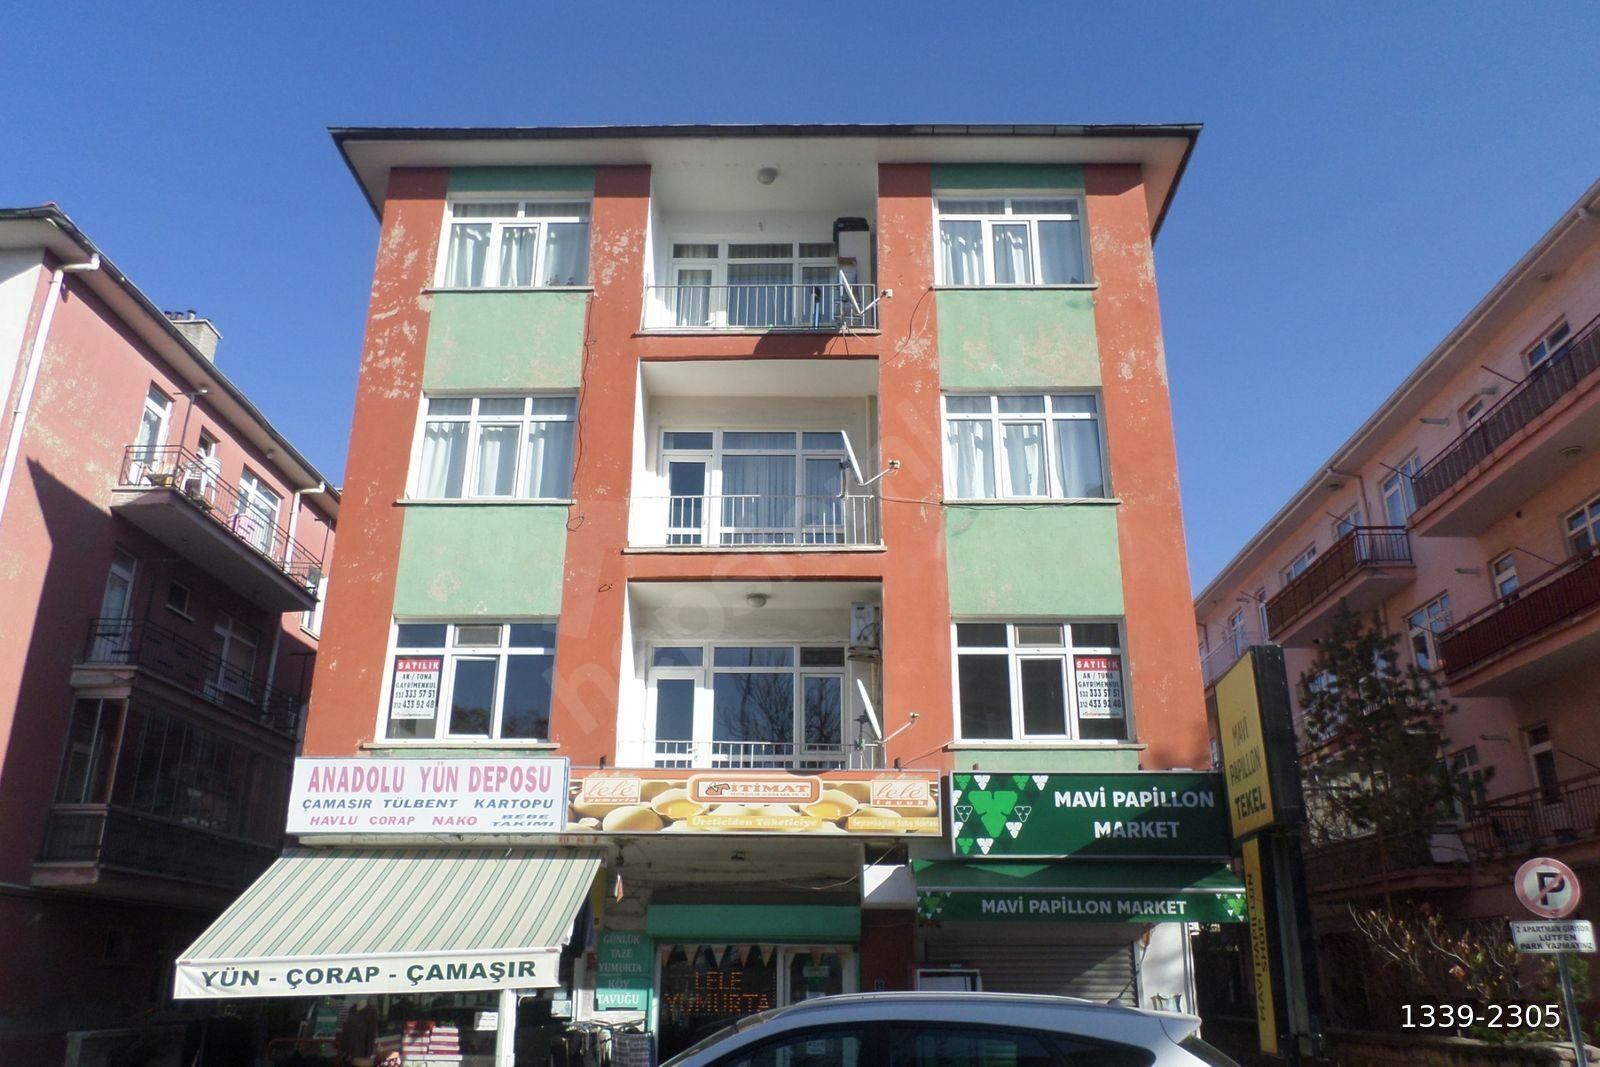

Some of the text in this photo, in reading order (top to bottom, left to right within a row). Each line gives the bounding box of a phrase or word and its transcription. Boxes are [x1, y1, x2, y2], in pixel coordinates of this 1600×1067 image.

[397, 661, 439, 670] SATILIK
[1076, 660, 1118, 669] SATILIK
[405, 690, 417, 698] 333
[1090, 689, 1102, 697] 333
[403, 700, 415, 708] 433
[1089, 700, 1102, 708] 433
[307, 762, 552, 793] ANADOLU YÜN DEPOSU
[731, 782, 809, 793] İTİMAT
[383, 797, 458, 809] TÜLBENT
[474, 799, 554, 809] KARTOPU
[1055, 787, 1214, 808] MAVİ PAPİLLON
[1235, 786, 1266, 820] TEKEL
[310, 816, 358, 826] HAVLU
[432, 816, 478, 826] NAKO
[1094, 821, 1180, 839] MARKET
[1536, 872, 1566, 906] P
[981, 896, 1187, 915] MAVİ PAPİLLON MARKET
[1520, 942, 1543, 950] PARK
[609, 948, 633, 959] TAZE
[599, 962, 642, 973] YUMURTA
[202, 967, 260, 987] YÜN
[286, 966, 380, 989] ÇORAP
[406, 961, 536, 985] ÇAMAŞIR
[695, 971, 743, 990] LELE
[596, 992, 640, 1005] TAVUĞU
[663, 993, 770, 1013] YUMURTA
